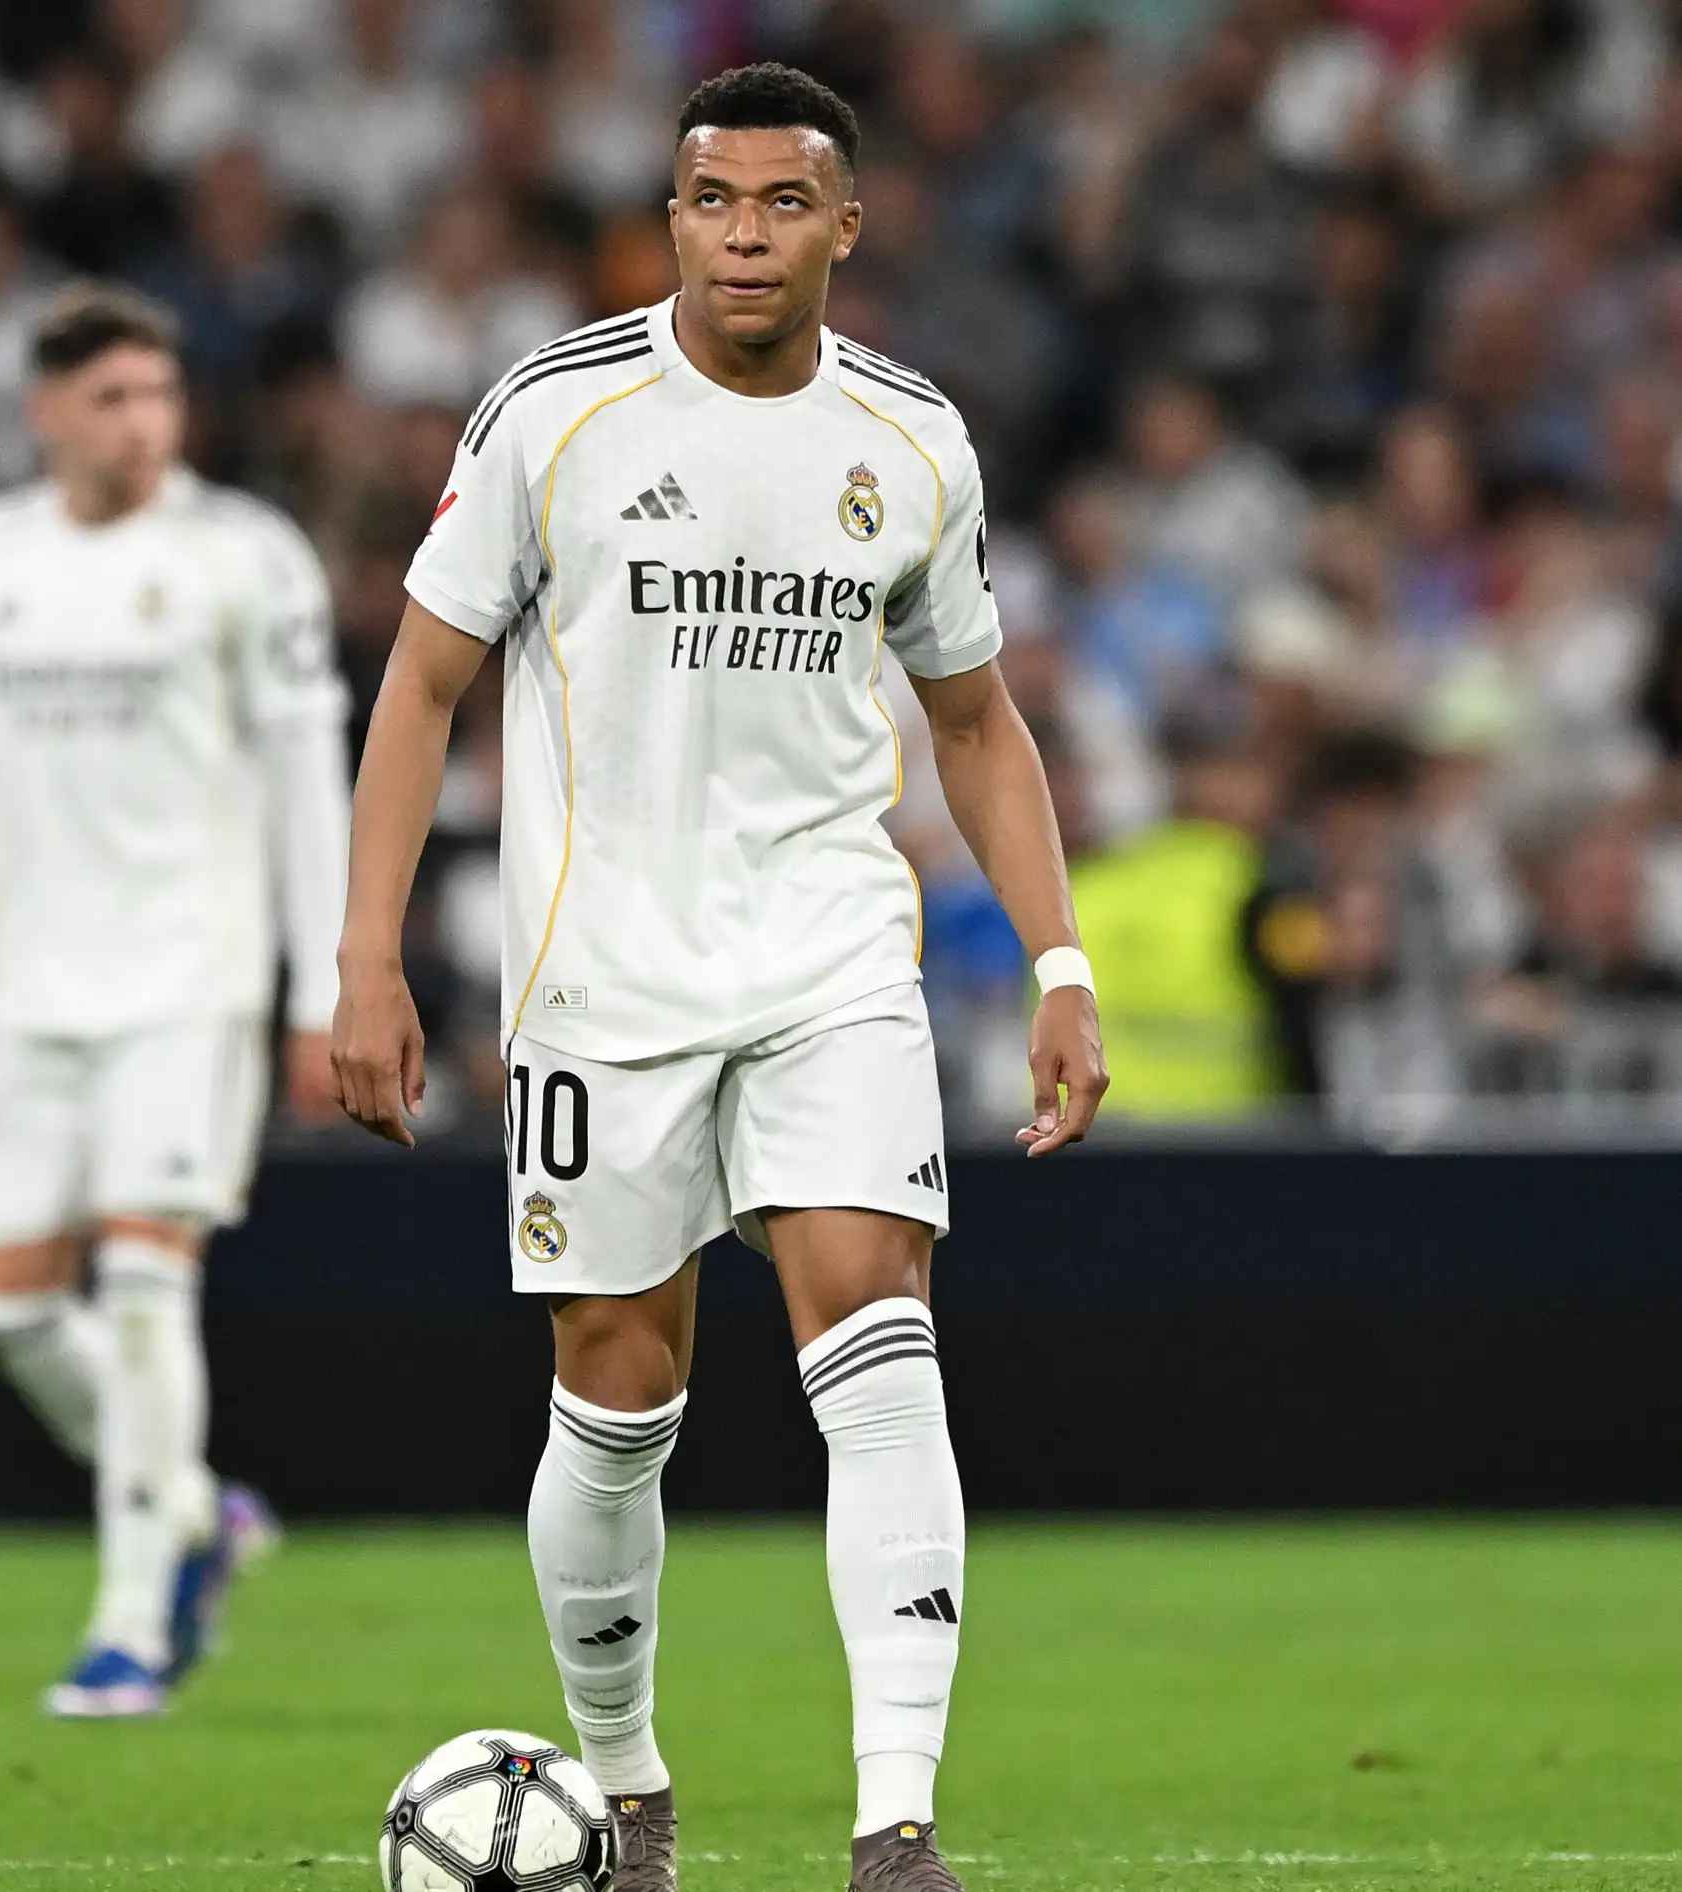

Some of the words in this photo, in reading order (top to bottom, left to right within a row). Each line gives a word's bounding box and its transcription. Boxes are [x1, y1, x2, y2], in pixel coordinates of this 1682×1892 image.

[627, 556, 875, 622] Emirates
[671, 625, 718, 669] FLY
[726, 626, 843, 674] BETTER
[512, 1065, 589, 1181] 10
